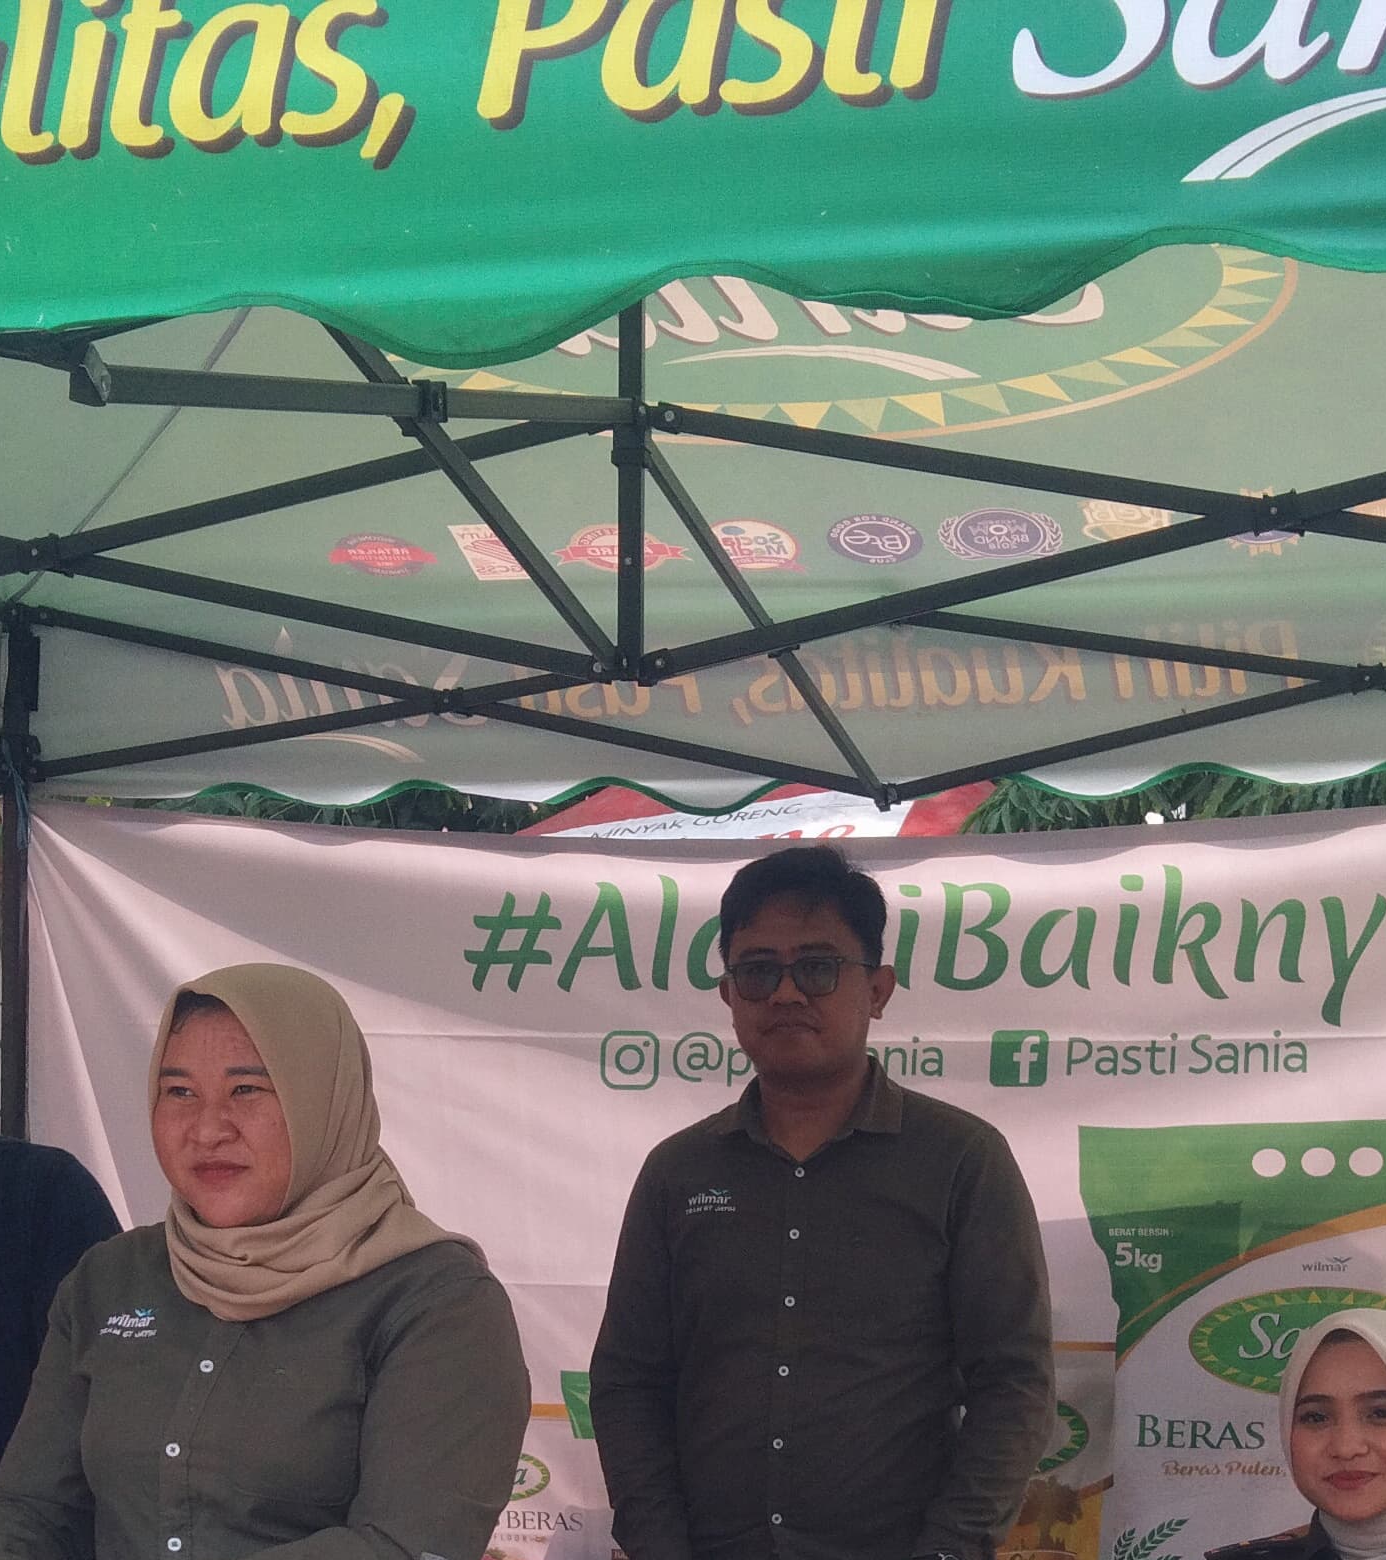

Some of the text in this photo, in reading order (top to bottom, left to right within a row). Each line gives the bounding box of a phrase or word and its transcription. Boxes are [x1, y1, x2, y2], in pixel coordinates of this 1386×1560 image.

[591, 803, 803, 840] MINYAK GORENG
[1066, 1029, 1309, 1076] Pasti Sania
[687, 1193, 732, 1206] wilmar
[1108, 1227, 1136, 1237] BERAT
[1115, 1242, 1163, 1272] 5kg
[1302, 1260, 1349, 1272] wilmar
[106, 1313, 156, 1328] wilmar
[1136, 1413, 1266, 1450] BERAS
[1162, 1460, 1221, 1476] Beras
[507, 1510, 584, 1532] BERAS
